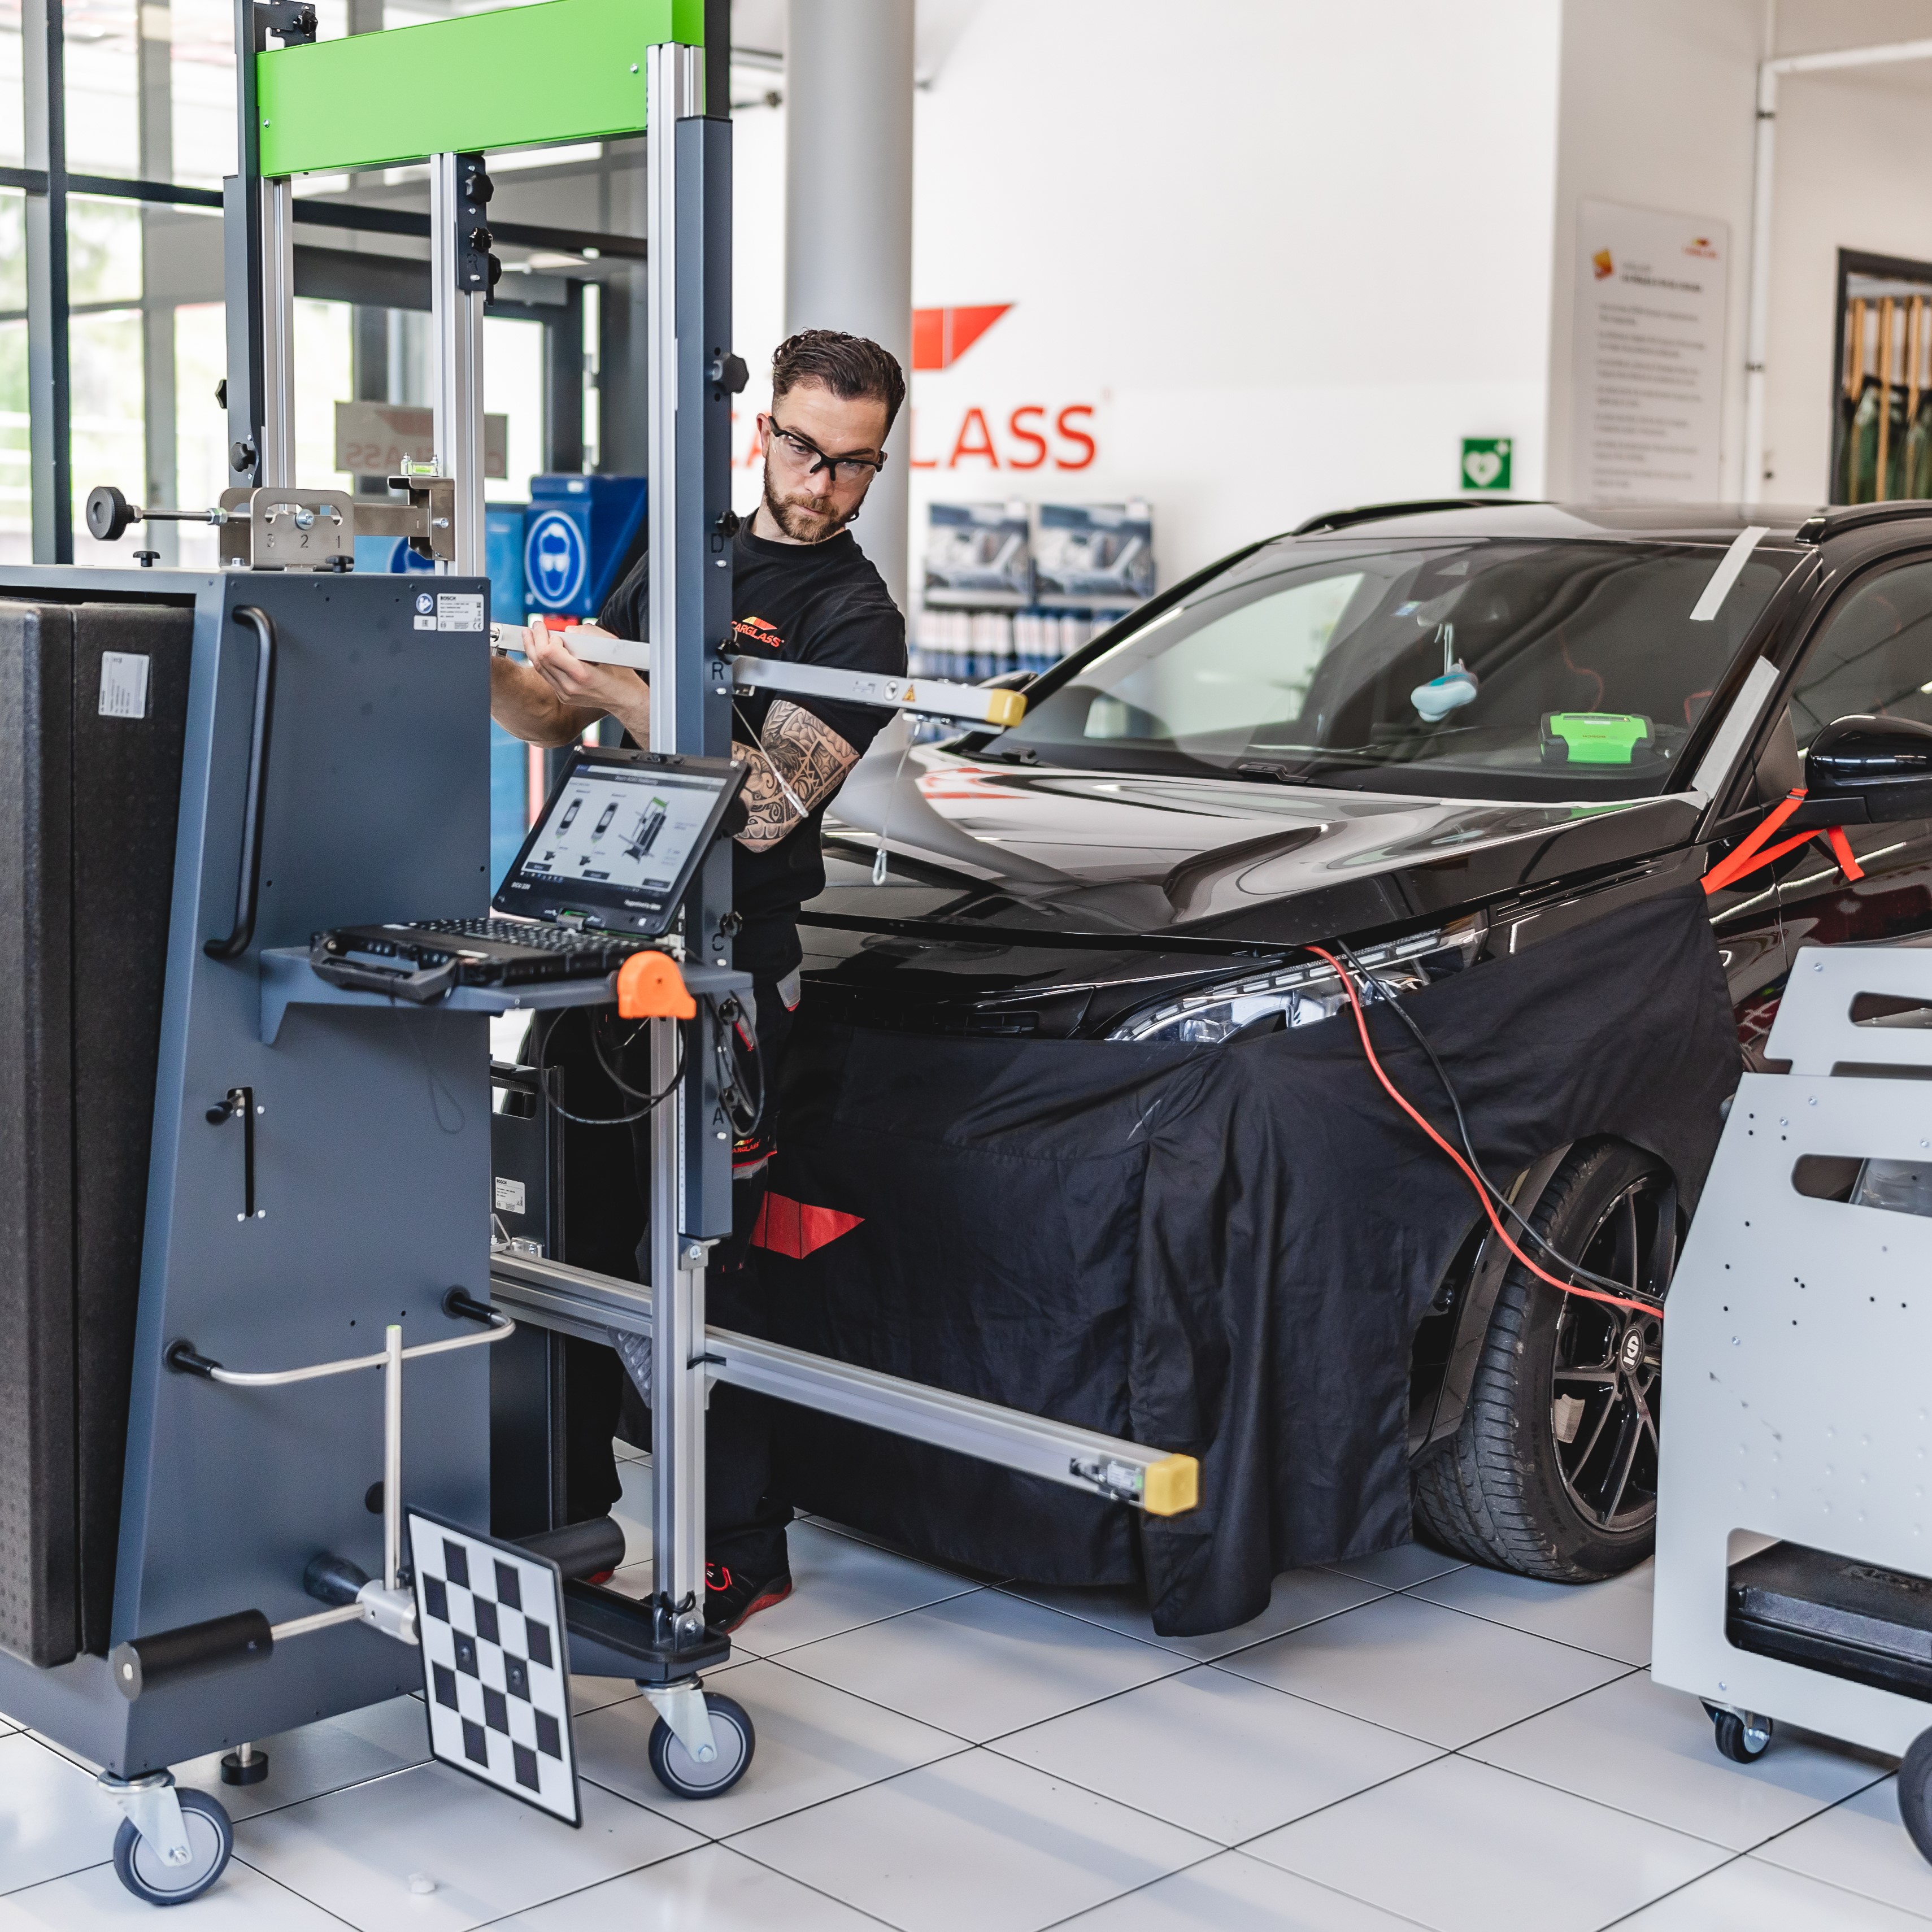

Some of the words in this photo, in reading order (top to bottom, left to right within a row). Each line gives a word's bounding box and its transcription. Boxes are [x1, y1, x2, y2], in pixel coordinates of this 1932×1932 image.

[267, 533, 275, 548] 3
[301, 534, 308, 549] 2
[336, 535, 341, 549] 1
[711, 533, 724, 553] D
[712, 662, 724, 681] R
[712, 933, 724, 952] C
[712, 1107, 724, 1125] A
[732, 1142, 760, 1154] ARGLASS
